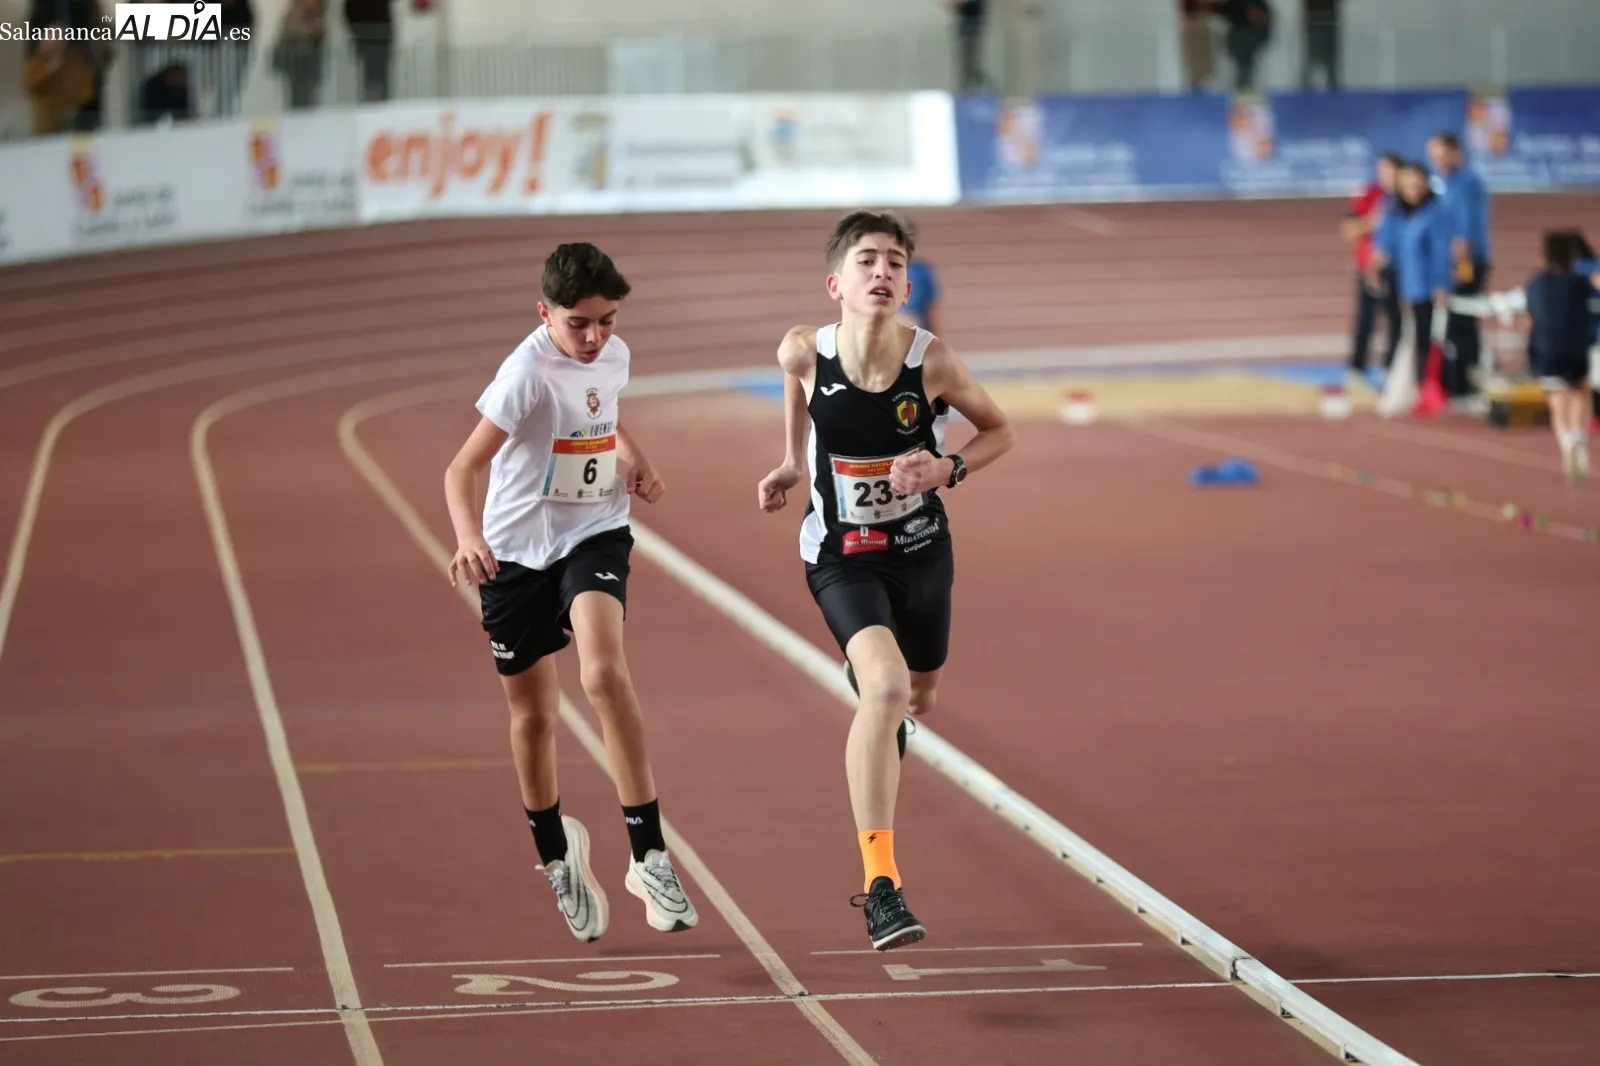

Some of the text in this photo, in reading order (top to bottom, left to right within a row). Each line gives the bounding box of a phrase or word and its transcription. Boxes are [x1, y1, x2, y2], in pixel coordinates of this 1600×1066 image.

[365, 110, 552, 197] enjoy!
[583, 458, 599, 485] 6
[854, 480, 907, 508] 23
[8, 982, 242, 1010] 3
[453, 968, 680, 997] 2
